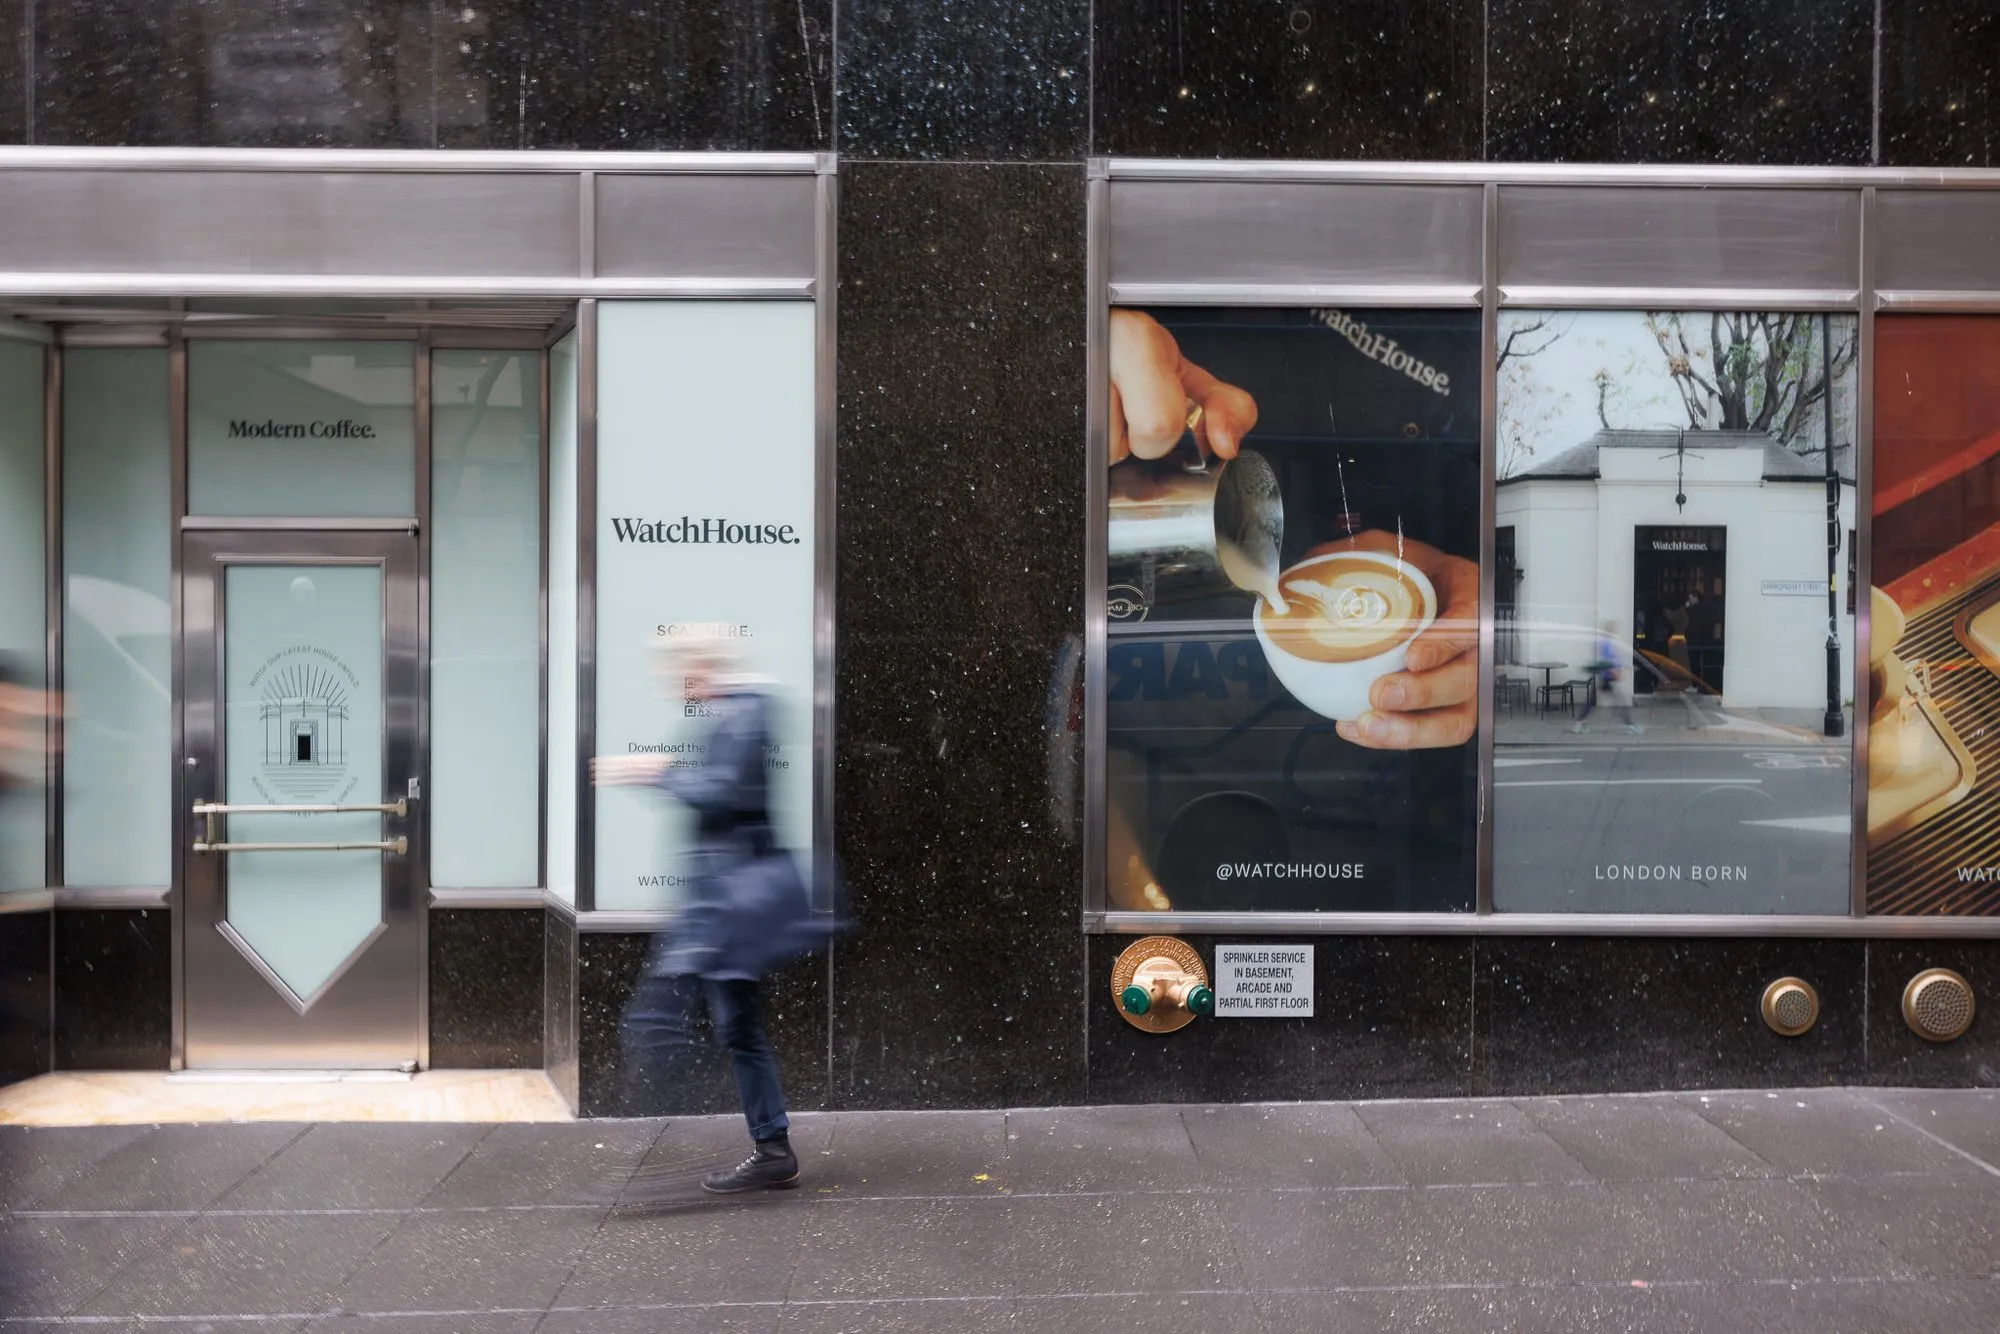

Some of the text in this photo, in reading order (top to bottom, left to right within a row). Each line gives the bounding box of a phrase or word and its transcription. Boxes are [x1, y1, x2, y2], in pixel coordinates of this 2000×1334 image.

[229, 419, 376, 439] Modern Coffee.
[611, 515, 800, 544] WatchHouse.
[1652, 540, 1708, 551] WatchHouse.
[628, 742, 706, 753] Download the
[1216, 863, 1364, 880] @WATCHHOUSE
[1595, 864, 1748, 881] LONDON BORN
[1223, 952, 1305, 963] SPRINKLER SERVICE
[1234, 967, 1293, 980] IN BASEMENT,
[1236, 982, 1292, 993] ARCADE AND
[1219, 997, 1309, 1008] PARTIAL FIRST FLOOR
